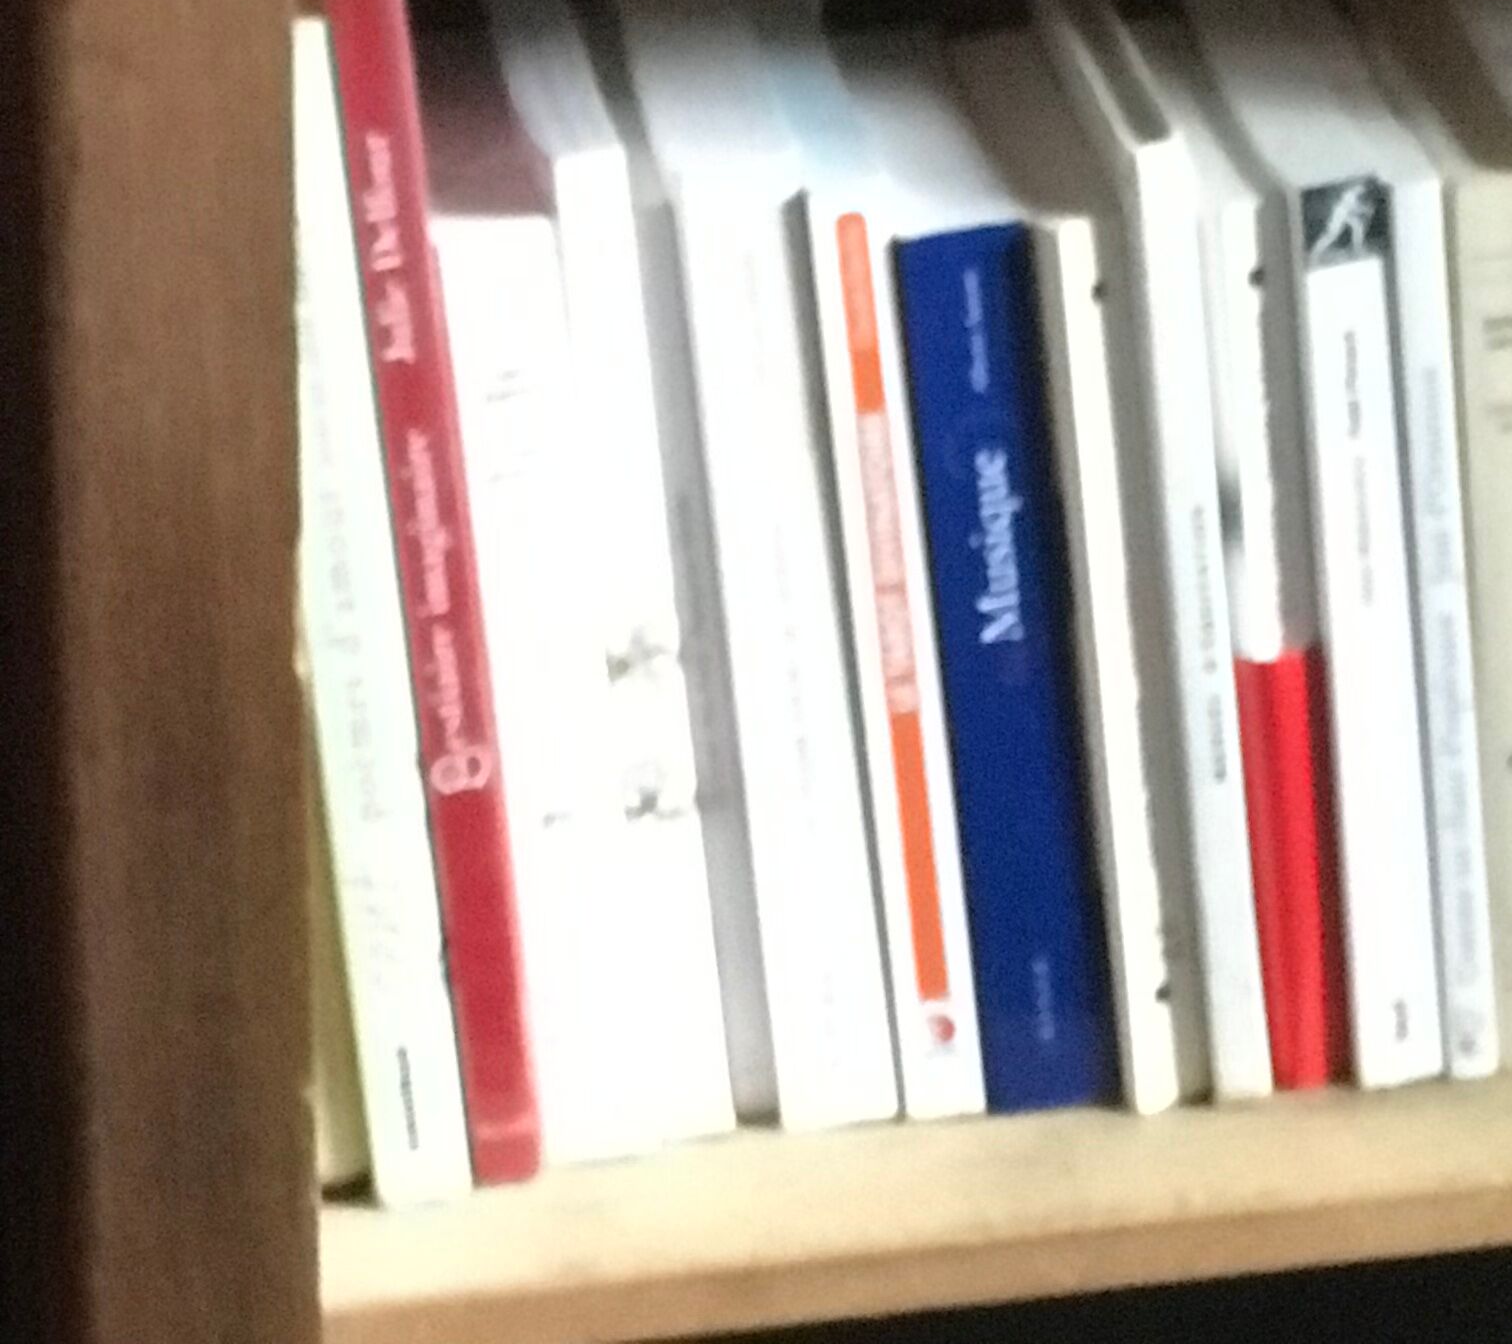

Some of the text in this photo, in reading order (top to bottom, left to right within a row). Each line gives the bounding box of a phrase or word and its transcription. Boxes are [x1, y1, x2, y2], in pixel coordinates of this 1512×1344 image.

[379, 281, 415, 365] Julie
[406, 426, 456, 616] imaginaire
[978, 448, 1032, 644] Musique
